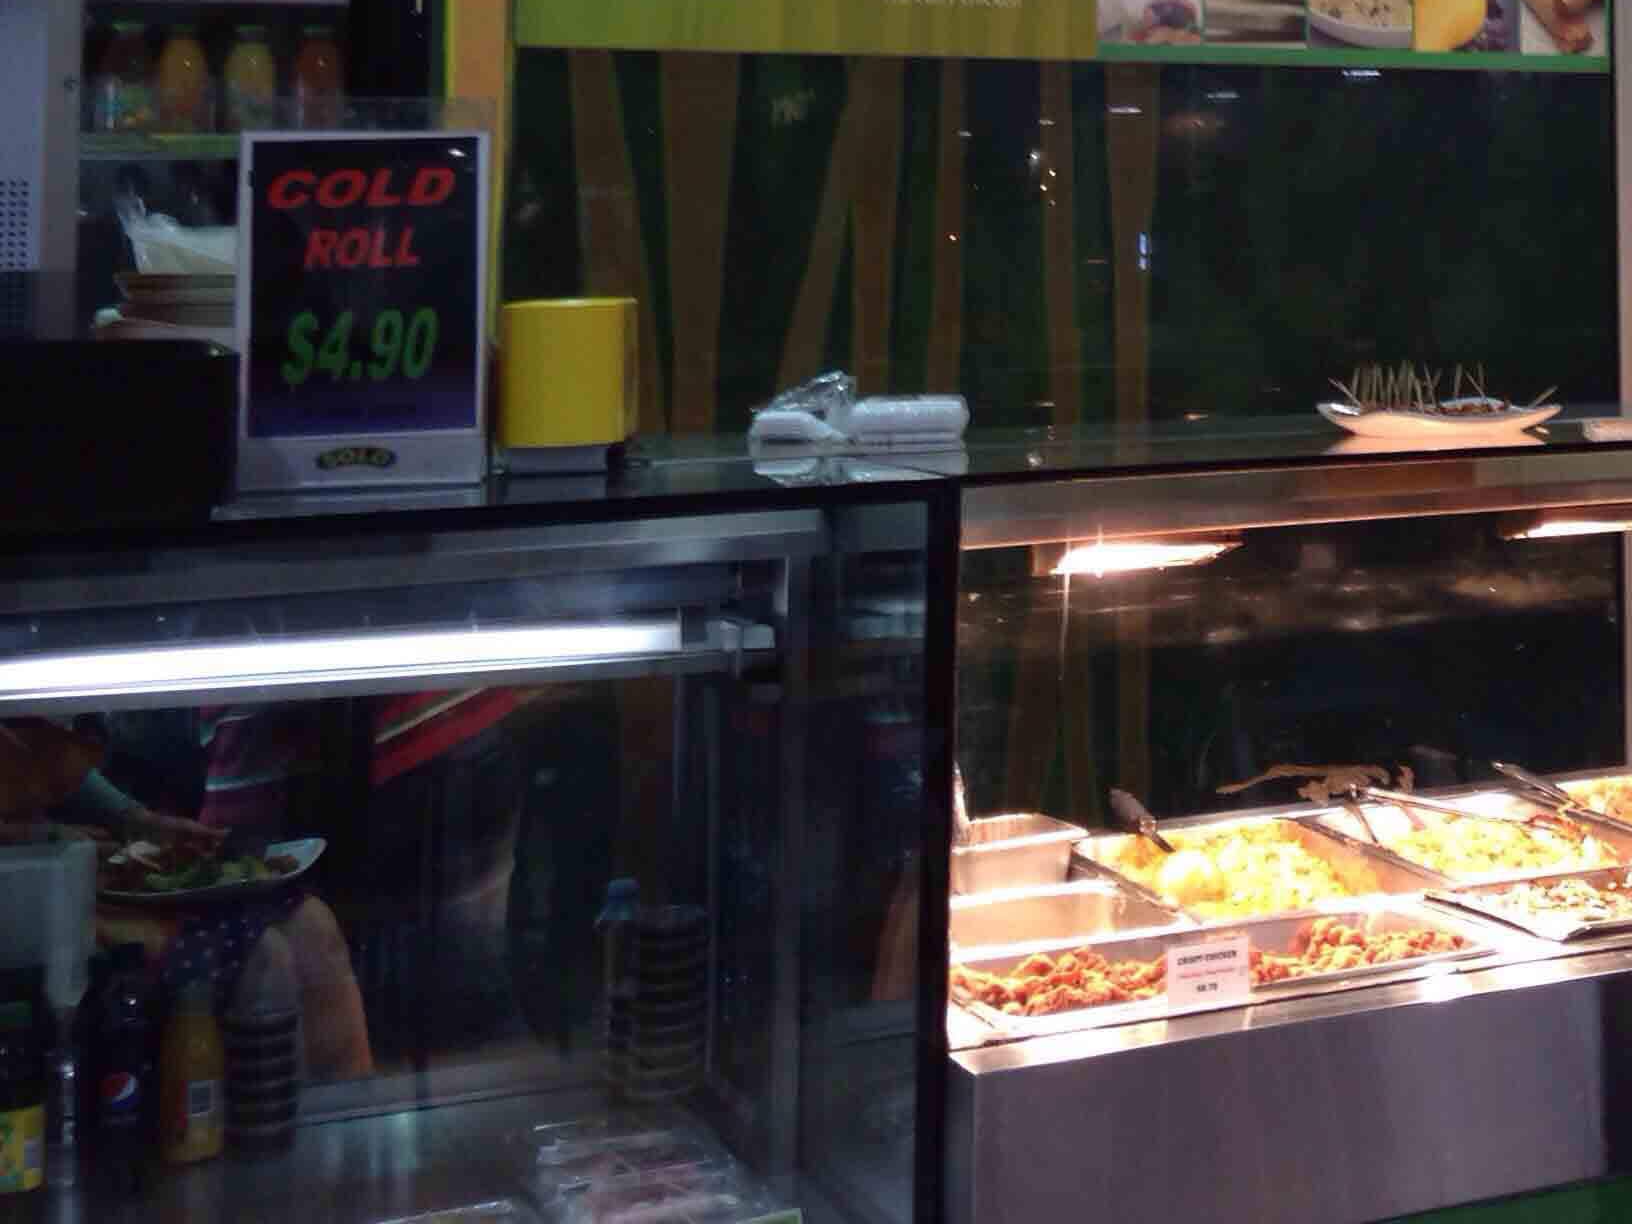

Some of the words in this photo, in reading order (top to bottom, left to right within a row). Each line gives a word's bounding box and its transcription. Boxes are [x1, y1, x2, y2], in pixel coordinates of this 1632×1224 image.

[267, 166, 456, 209] COLD
[303, 226, 421, 269] ROLL
[281, 306, 440, 385] $4.90
